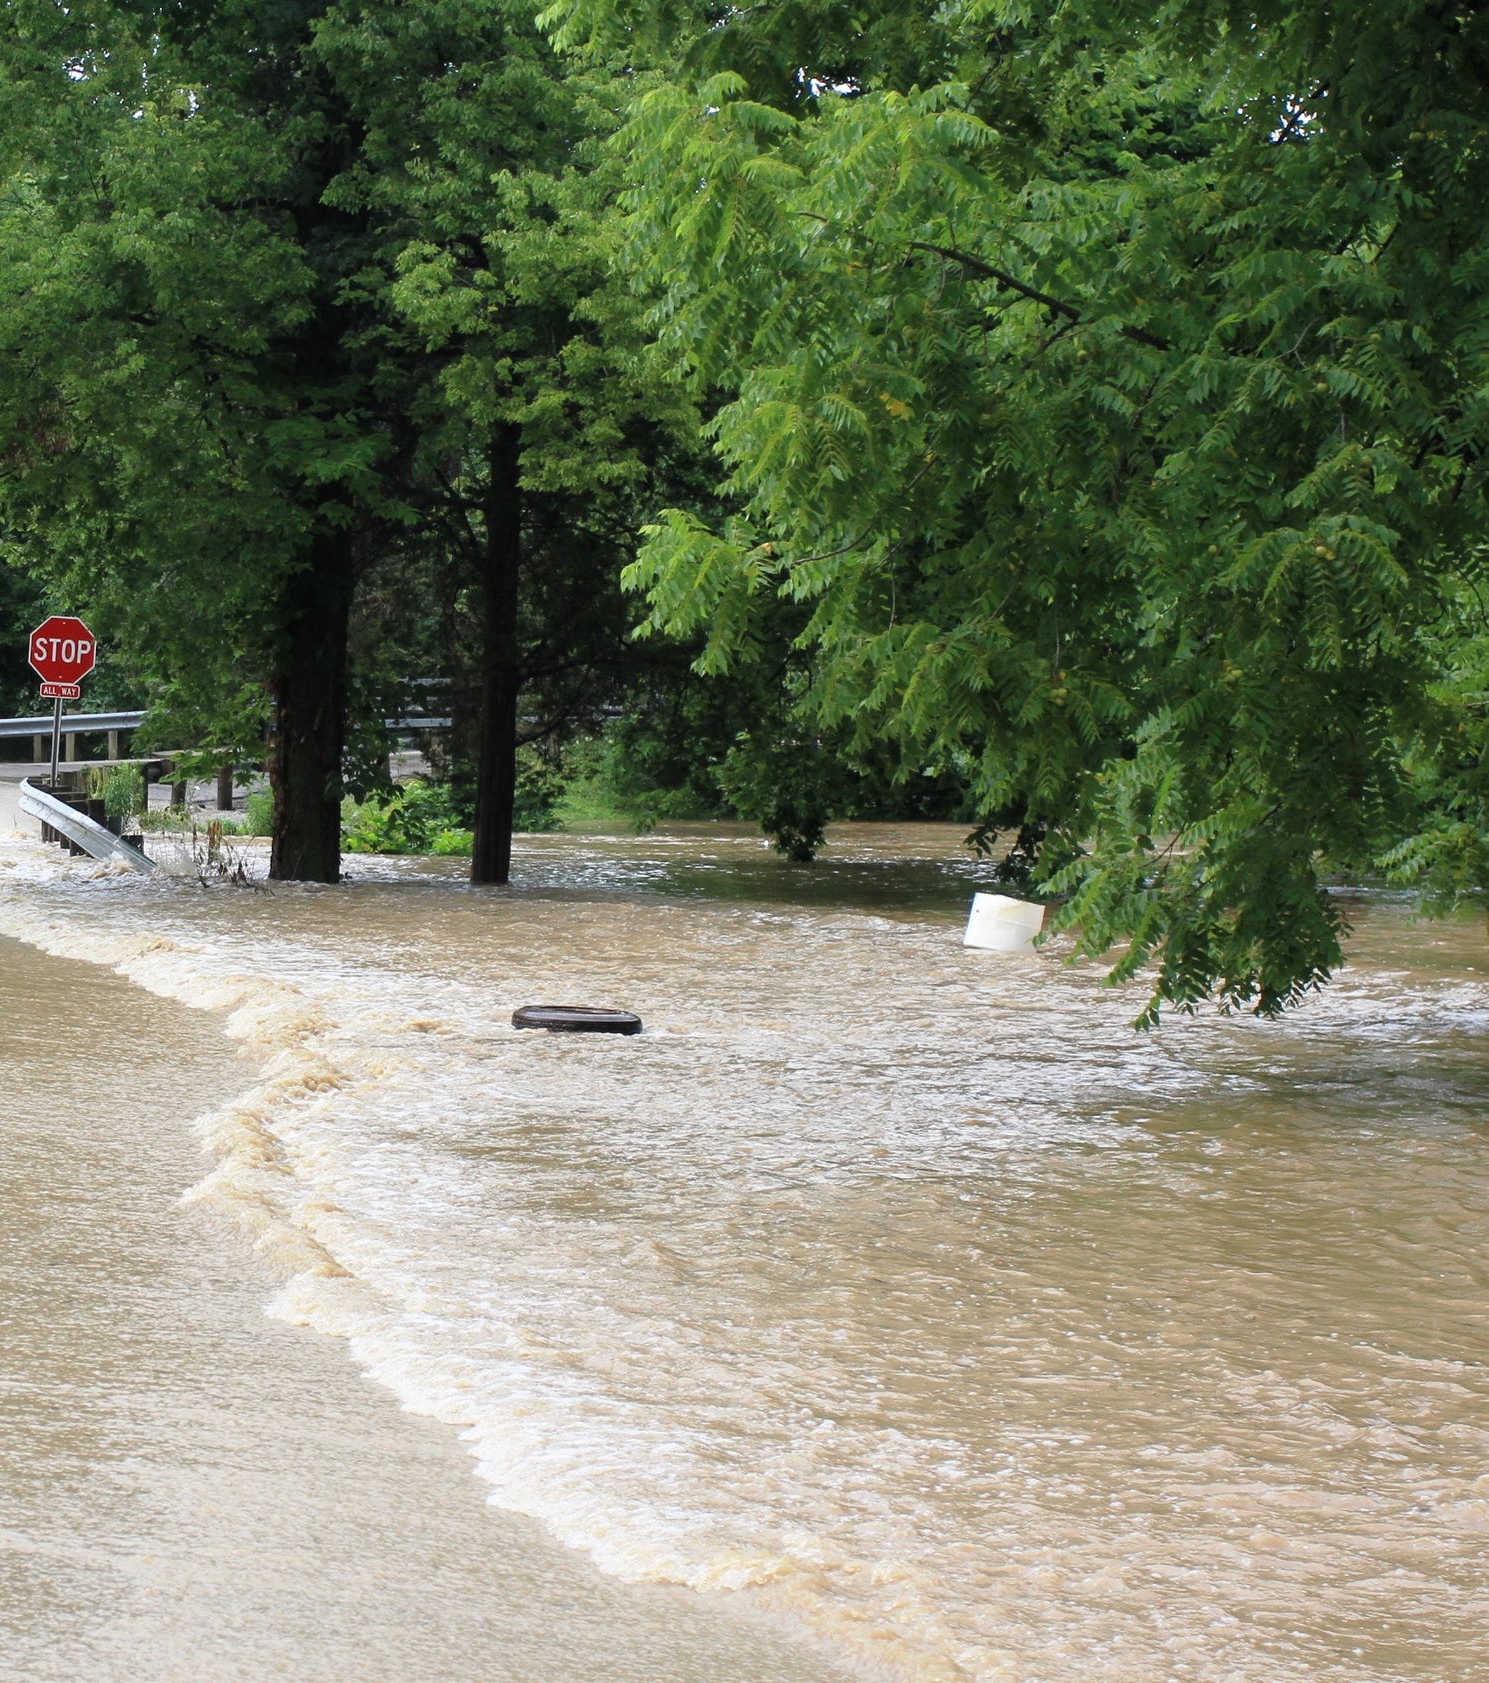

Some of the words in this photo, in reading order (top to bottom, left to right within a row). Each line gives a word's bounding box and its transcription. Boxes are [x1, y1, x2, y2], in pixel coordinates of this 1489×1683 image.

[34, 638, 91, 664] STOP
[43, 686, 57, 695] ALL
[61, 688, 77, 696] WAY
